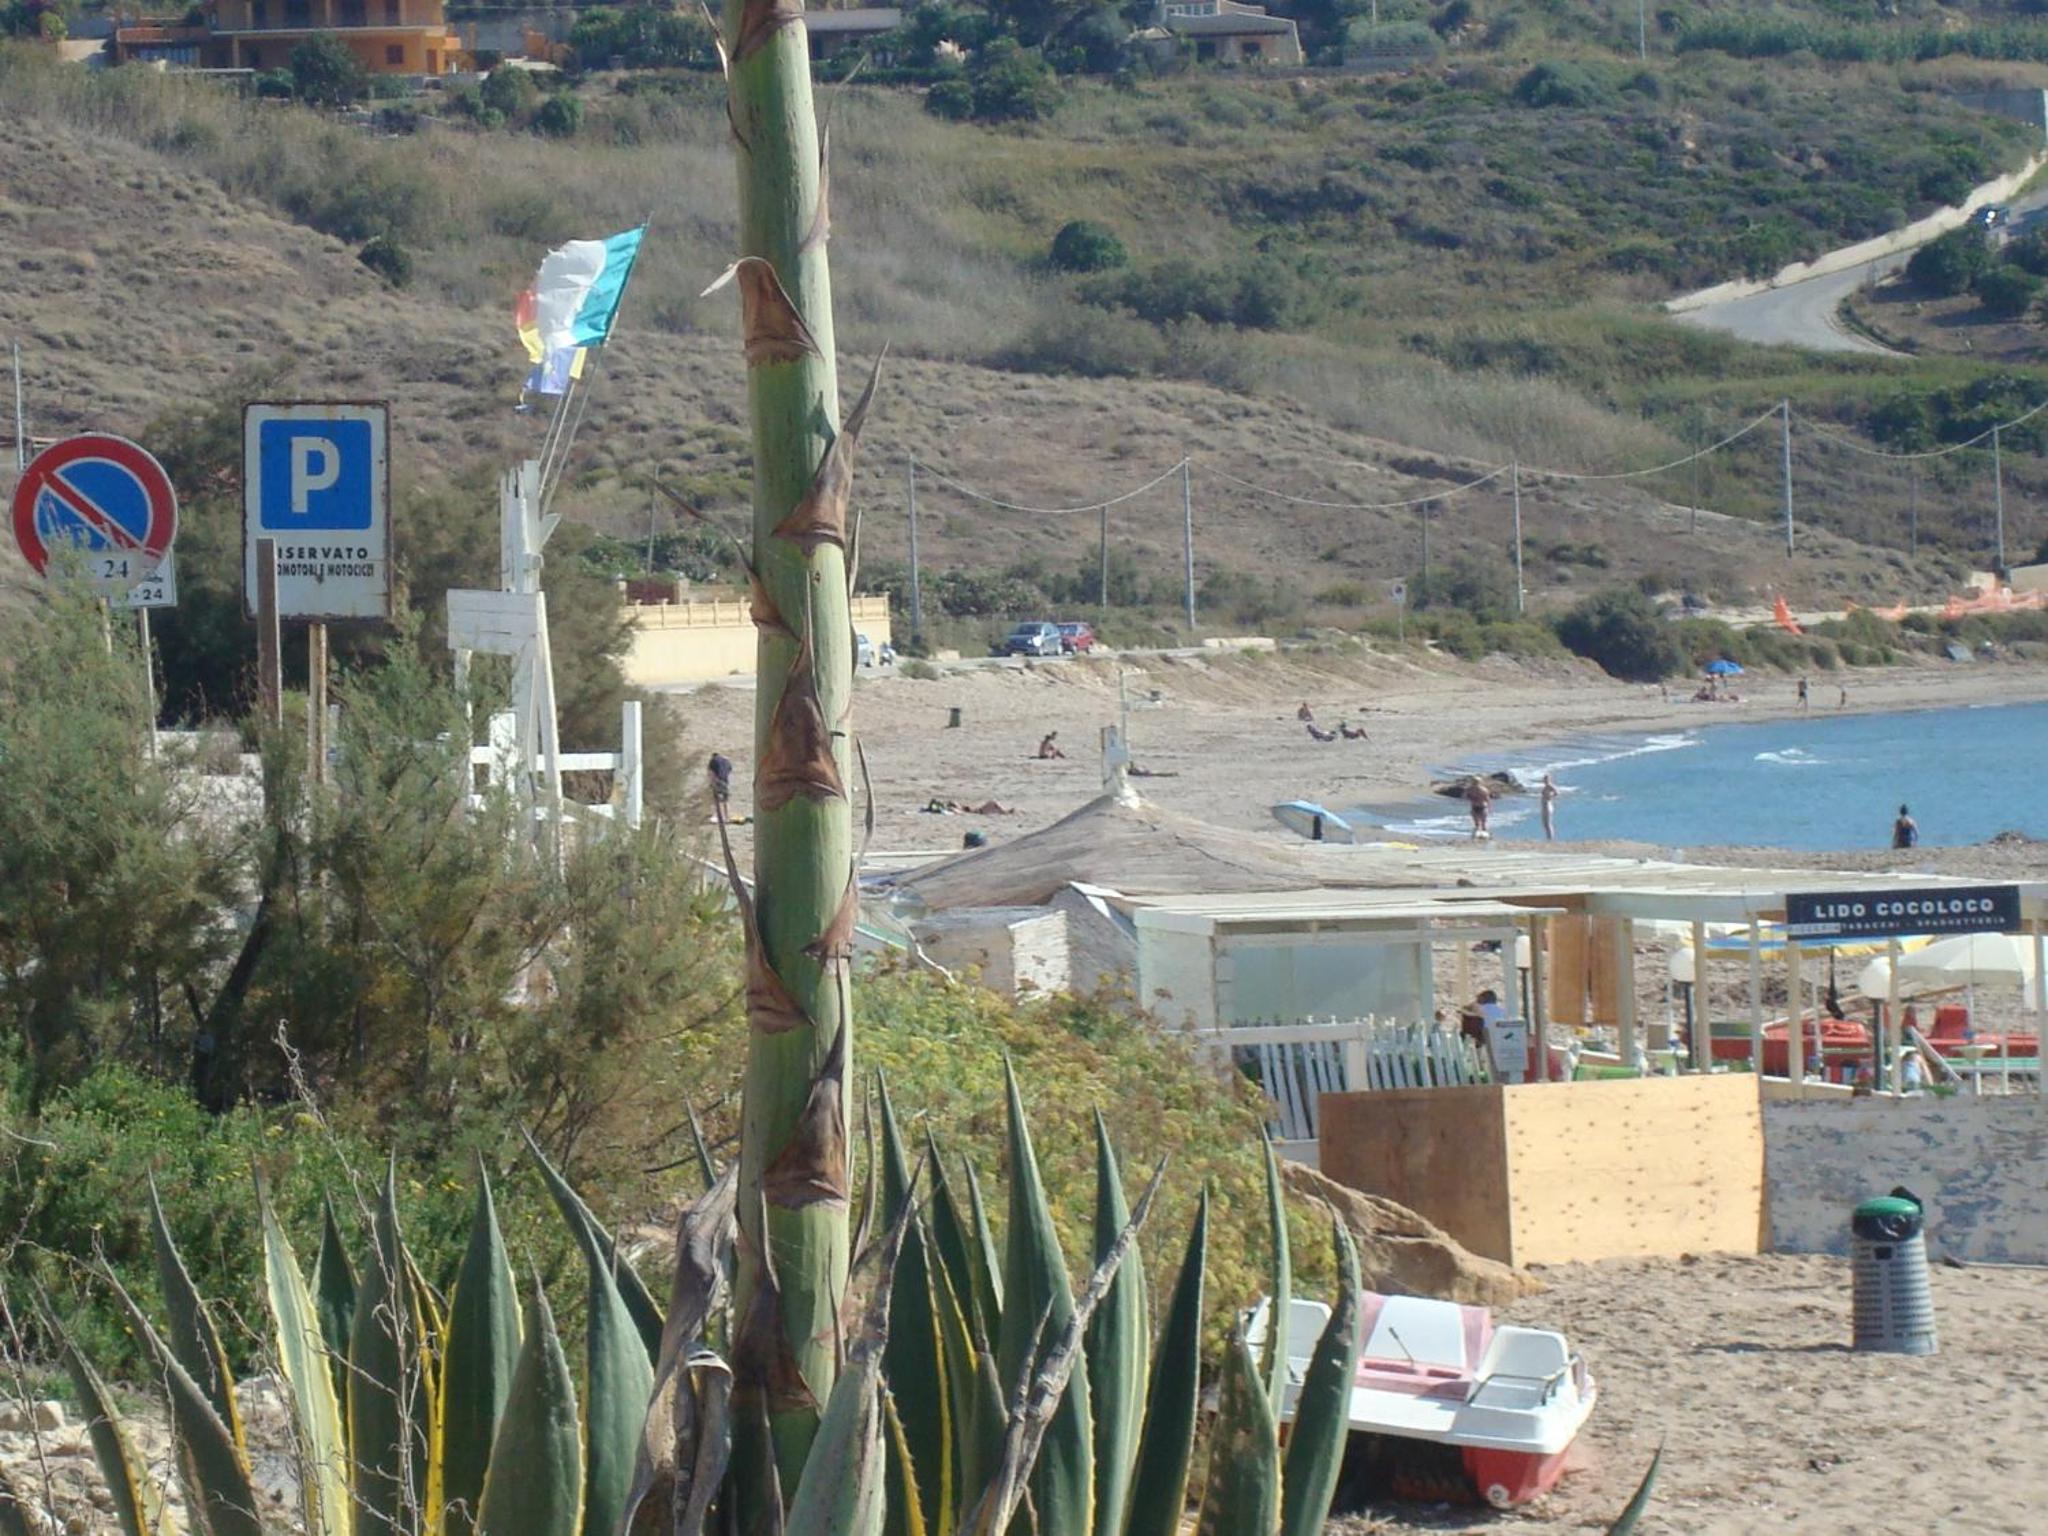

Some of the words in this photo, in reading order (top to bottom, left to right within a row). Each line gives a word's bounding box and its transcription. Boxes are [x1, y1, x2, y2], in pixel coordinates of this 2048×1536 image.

[290, 436, 340, 514] P
[277, 547, 369, 560] ISERVATO
[104, 559, 128, 578] 24
[1815, 903, 1866, 918] LIDO
[1876, 898, 1995, 916] COCOLOCO
